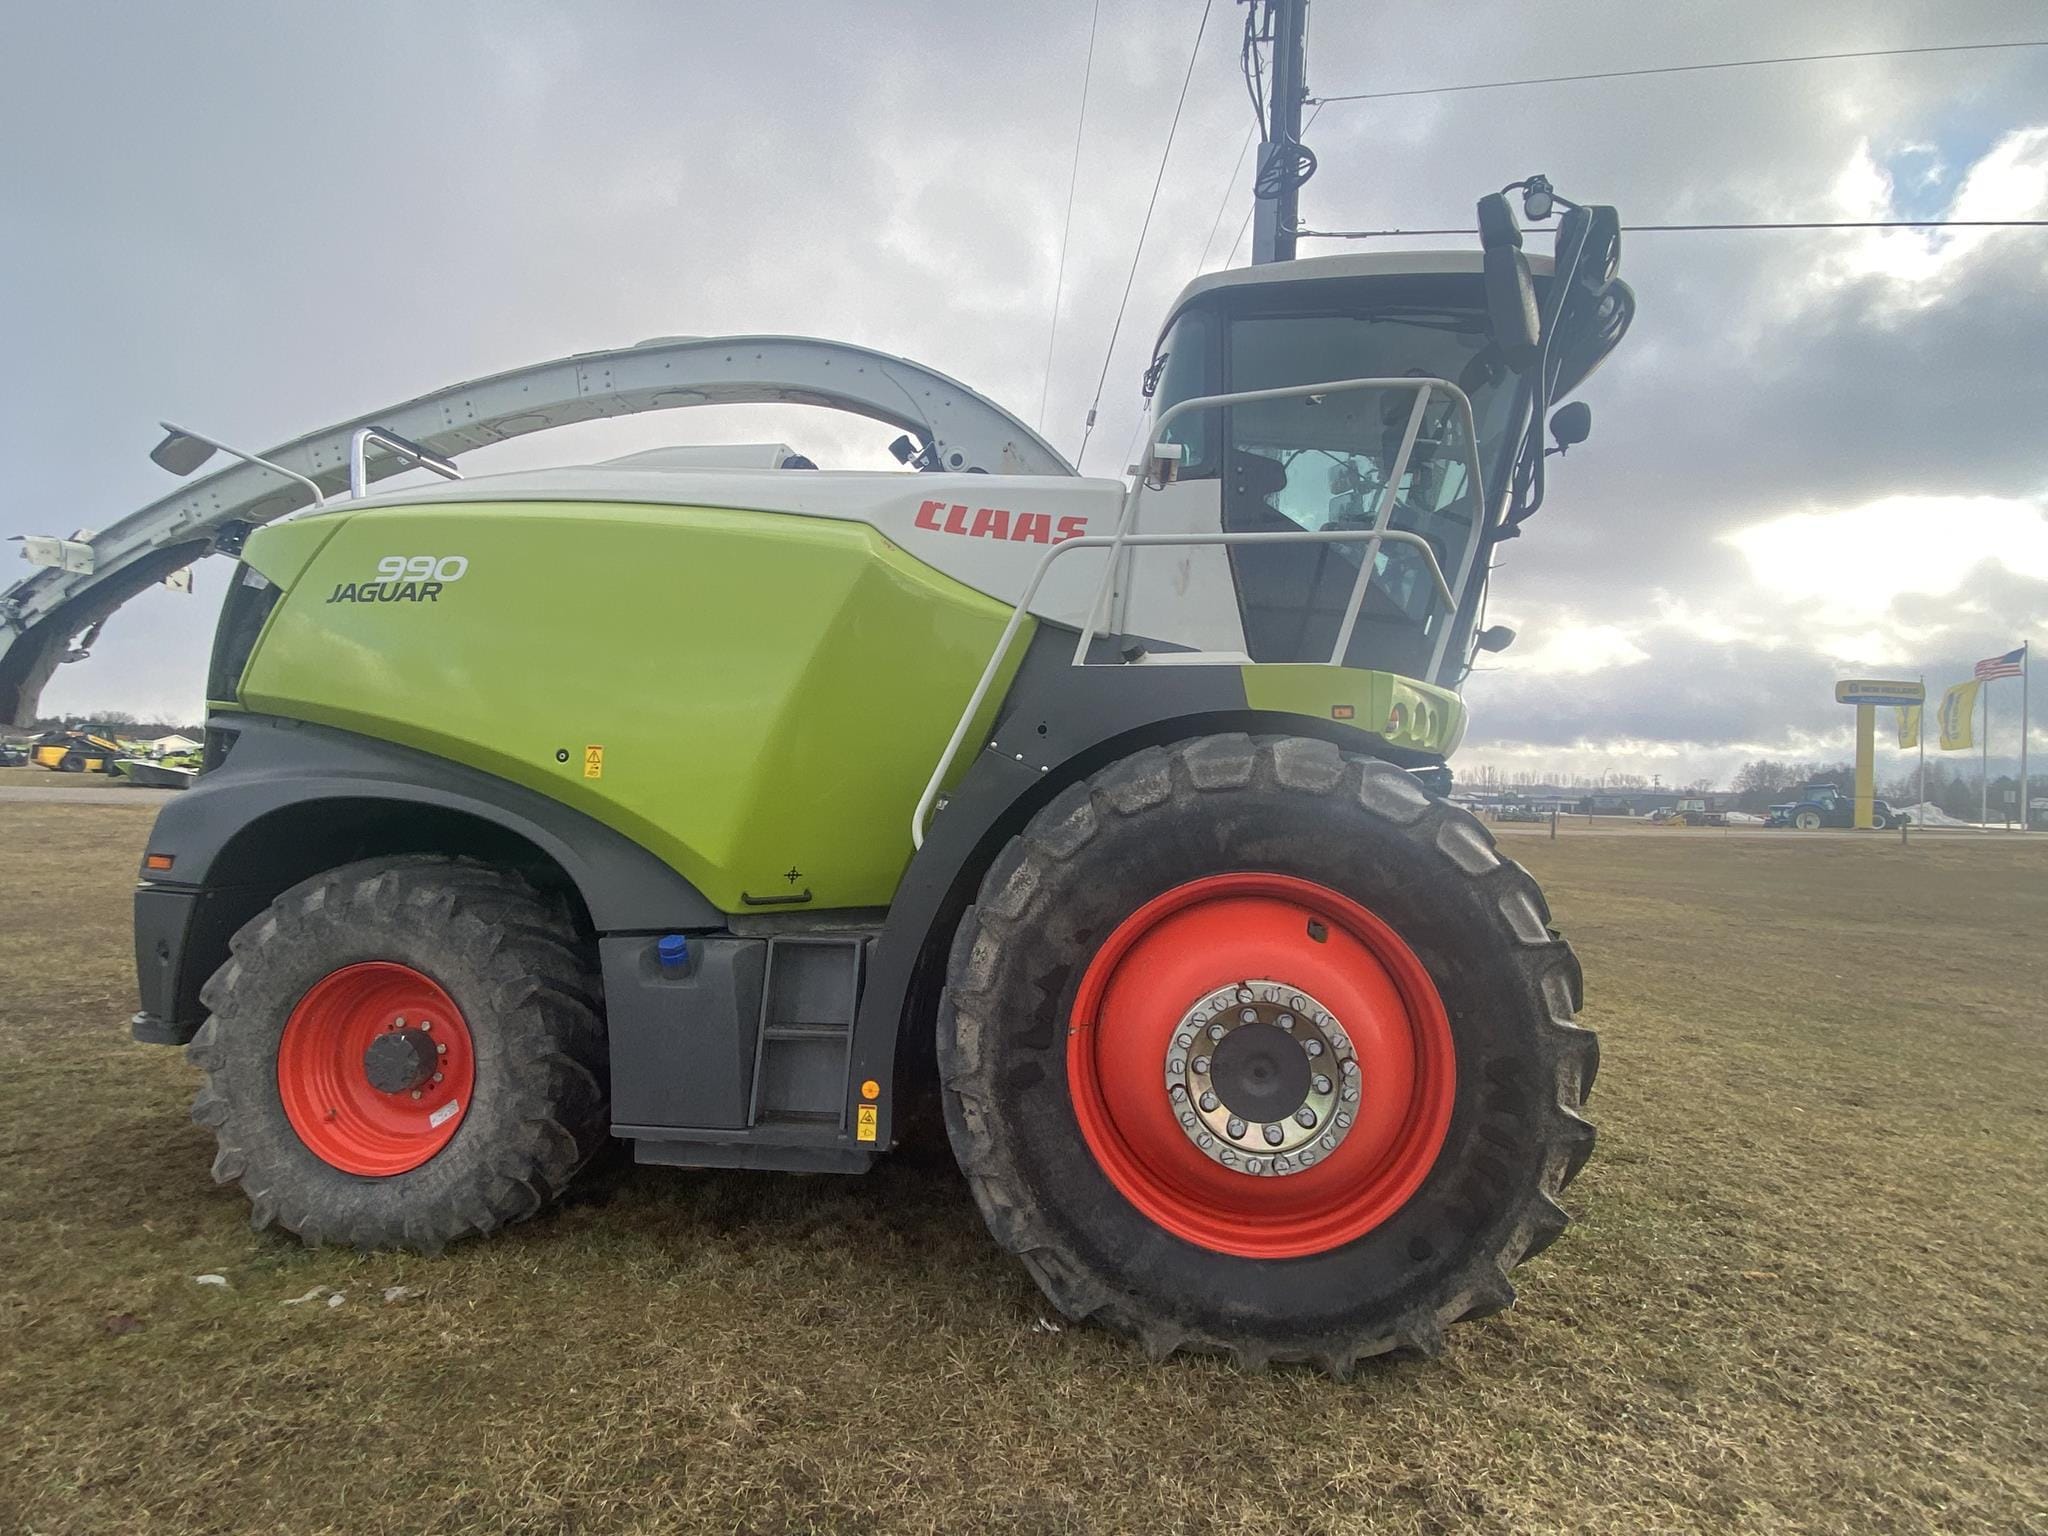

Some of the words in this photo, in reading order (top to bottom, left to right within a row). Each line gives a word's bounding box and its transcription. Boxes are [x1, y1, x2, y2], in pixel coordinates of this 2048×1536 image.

[914, 500, 1089, 545] CLAAS
[374, 555, 469, 583] 990
[326, 582, 443, 604] JAGUAR
